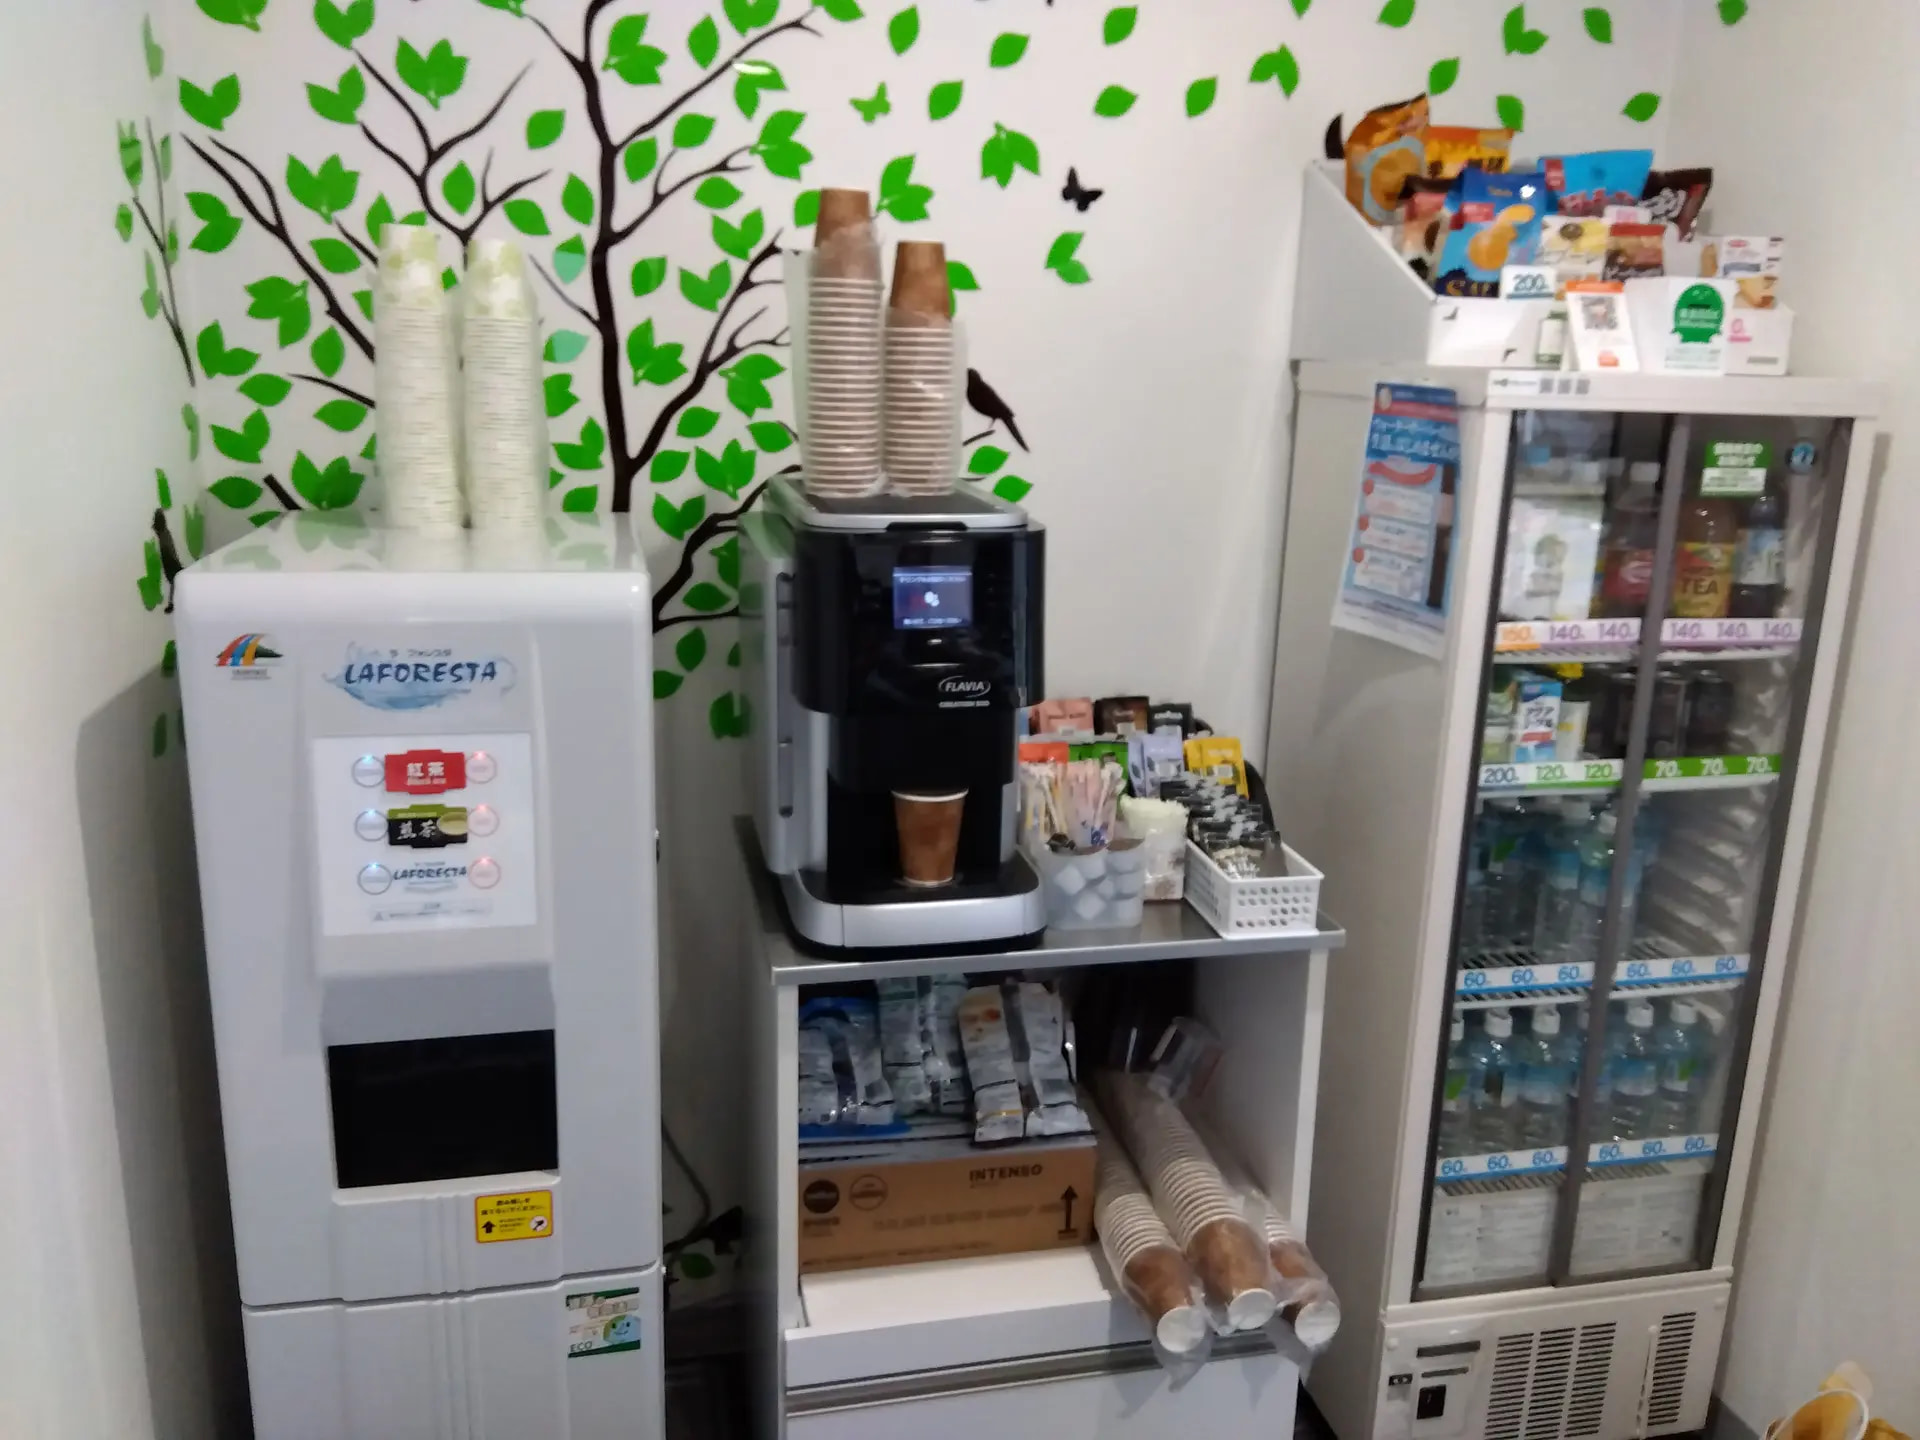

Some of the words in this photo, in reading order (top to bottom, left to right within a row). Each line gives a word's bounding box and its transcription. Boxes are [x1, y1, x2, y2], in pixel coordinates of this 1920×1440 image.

[1681, 578, 1718, 595] TEA
[345, 661, 497, 685] LAFORESTA
[945, 681, 984, 692] FLAVIA
[394, 866, 467, 881] LAFORESTA
[969, 1164, 1043, 1182] INTENSO
[570, 1341, 592, 1352] ECO
